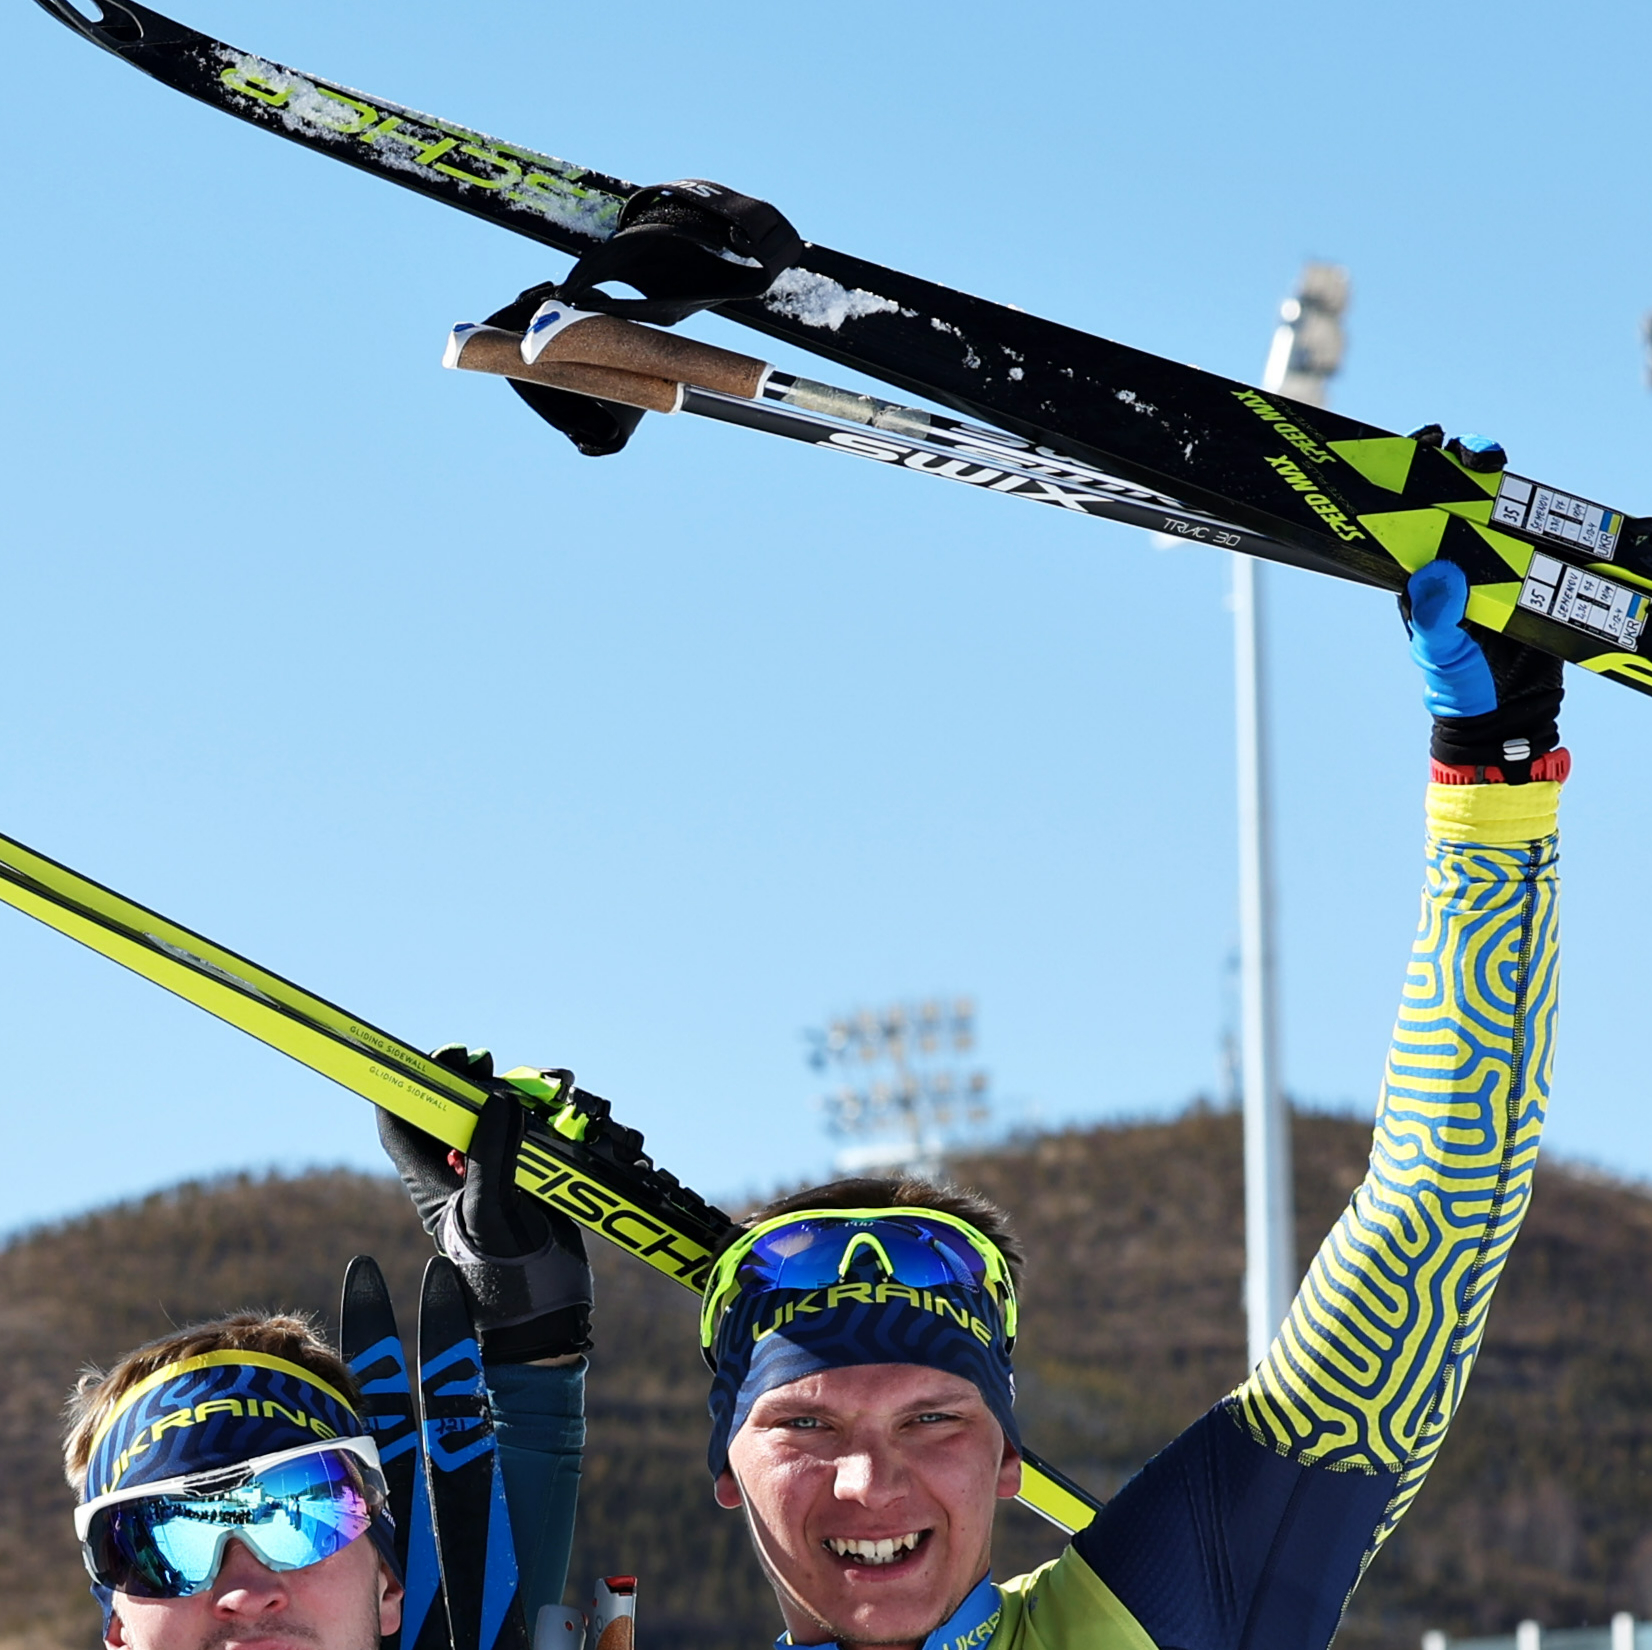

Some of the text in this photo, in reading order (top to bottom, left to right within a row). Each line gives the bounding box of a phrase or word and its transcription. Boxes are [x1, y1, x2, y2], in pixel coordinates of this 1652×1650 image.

[1230, 389, 1337, 464] SPEED MAX
[1263, 454, 1366, 541] SPEED MAX
[1503, 505, 1520, 522] 35
[1530, 494, 1548, 531] SEMENOV
[1163, 517, 1241, 547] TRIAC 30
[1598, 533, 1614, 556] UKR
[1530, 588, 1546, 608] 35
[1557, 573, 1579, 617] SEMENOV
[1621, 620, 1639, 646] UKR
[350, 1025, 427, 1073] GLIDING SIDEWALL
[368, 1065, 449, 1112] GLIDING SIDEWALL
[517, 1150, 709, 1294] FISCH
[752, 1281, 993, 1349] UKRAINE
